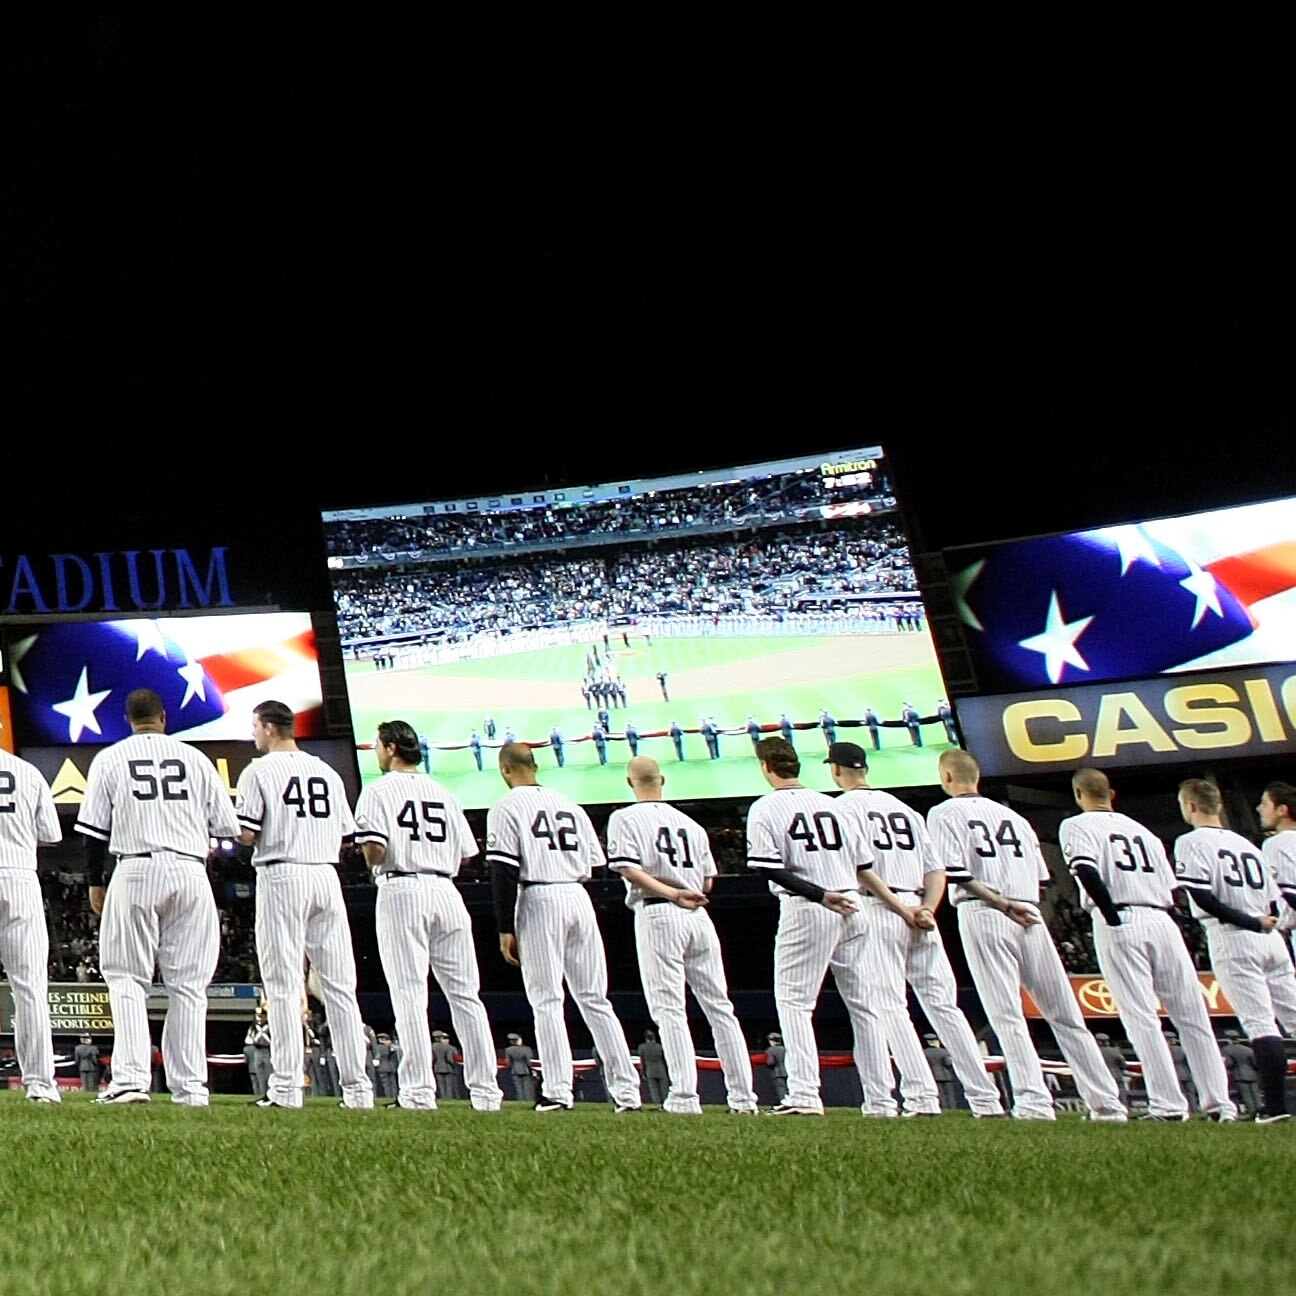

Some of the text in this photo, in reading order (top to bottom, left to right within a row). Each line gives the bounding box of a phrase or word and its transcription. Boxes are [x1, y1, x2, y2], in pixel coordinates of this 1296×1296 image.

[820, 460, 876, 476] Armitron
[1002, 676, 1296, 763] CASI
[128, 759, 189, 801] 52
[282, 776, 331, 818] 48
[397, 800, 447, 843] 45
[530, 810, 579, 851] 42
[787, 811, 843, 852] 40
[867, 811, 915, 851] 39
[968, 820, 1024, 858] 34
[655, 826, 694, 868] 41
[1109, 834, 1155, 873] 31
[1217, 849, 1265, 890] 30
